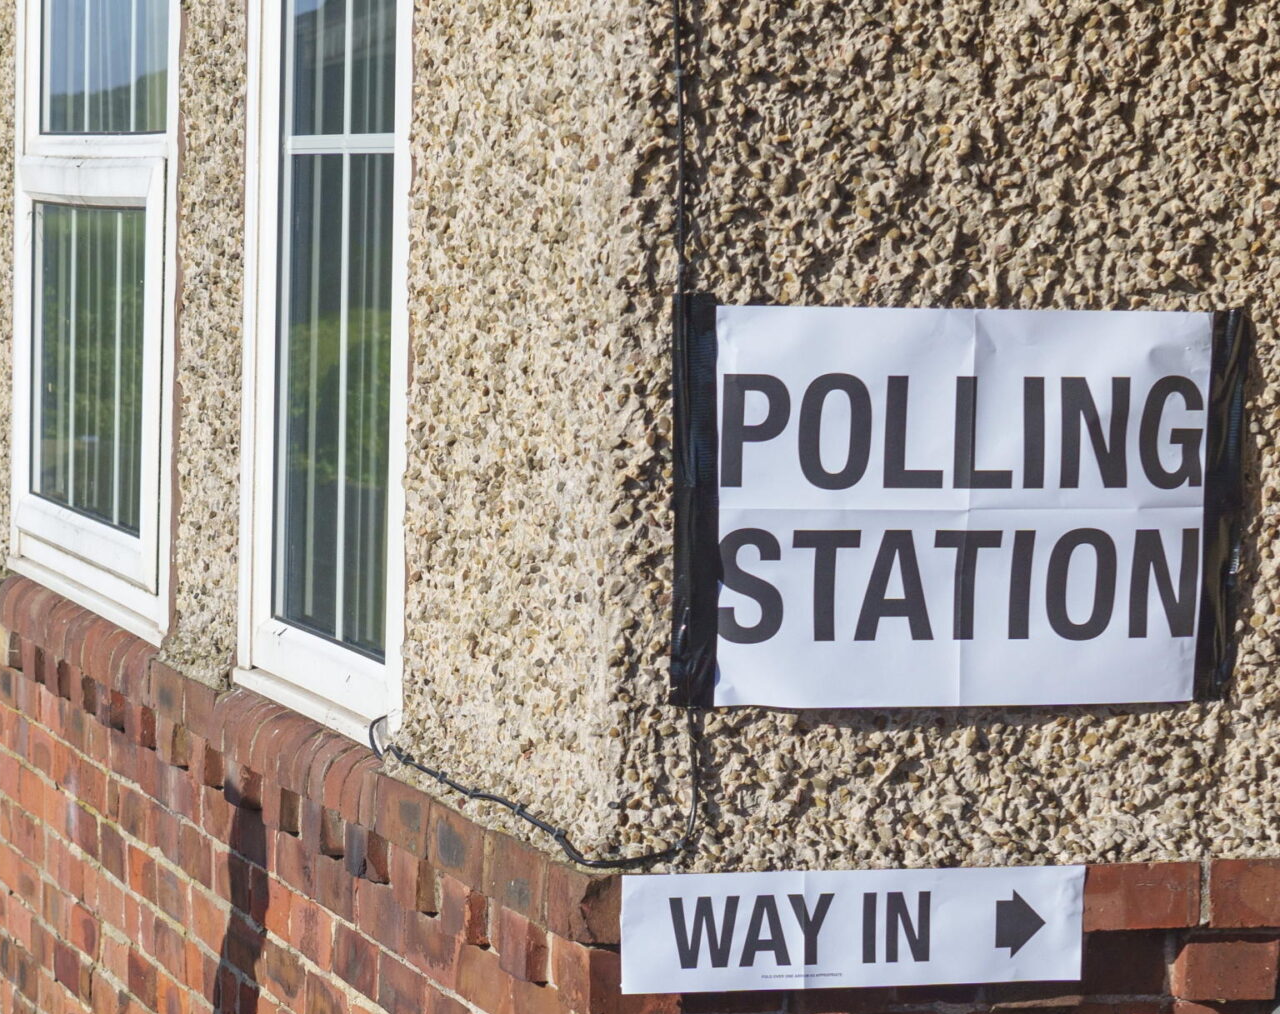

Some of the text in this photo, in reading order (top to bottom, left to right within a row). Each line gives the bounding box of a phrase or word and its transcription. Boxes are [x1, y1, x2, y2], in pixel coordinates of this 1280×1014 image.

[720, 373, 1204, 491] POLLING
[717, 527, 1200, 645] STATION
[669, 890, 932, 969] WAY IN
